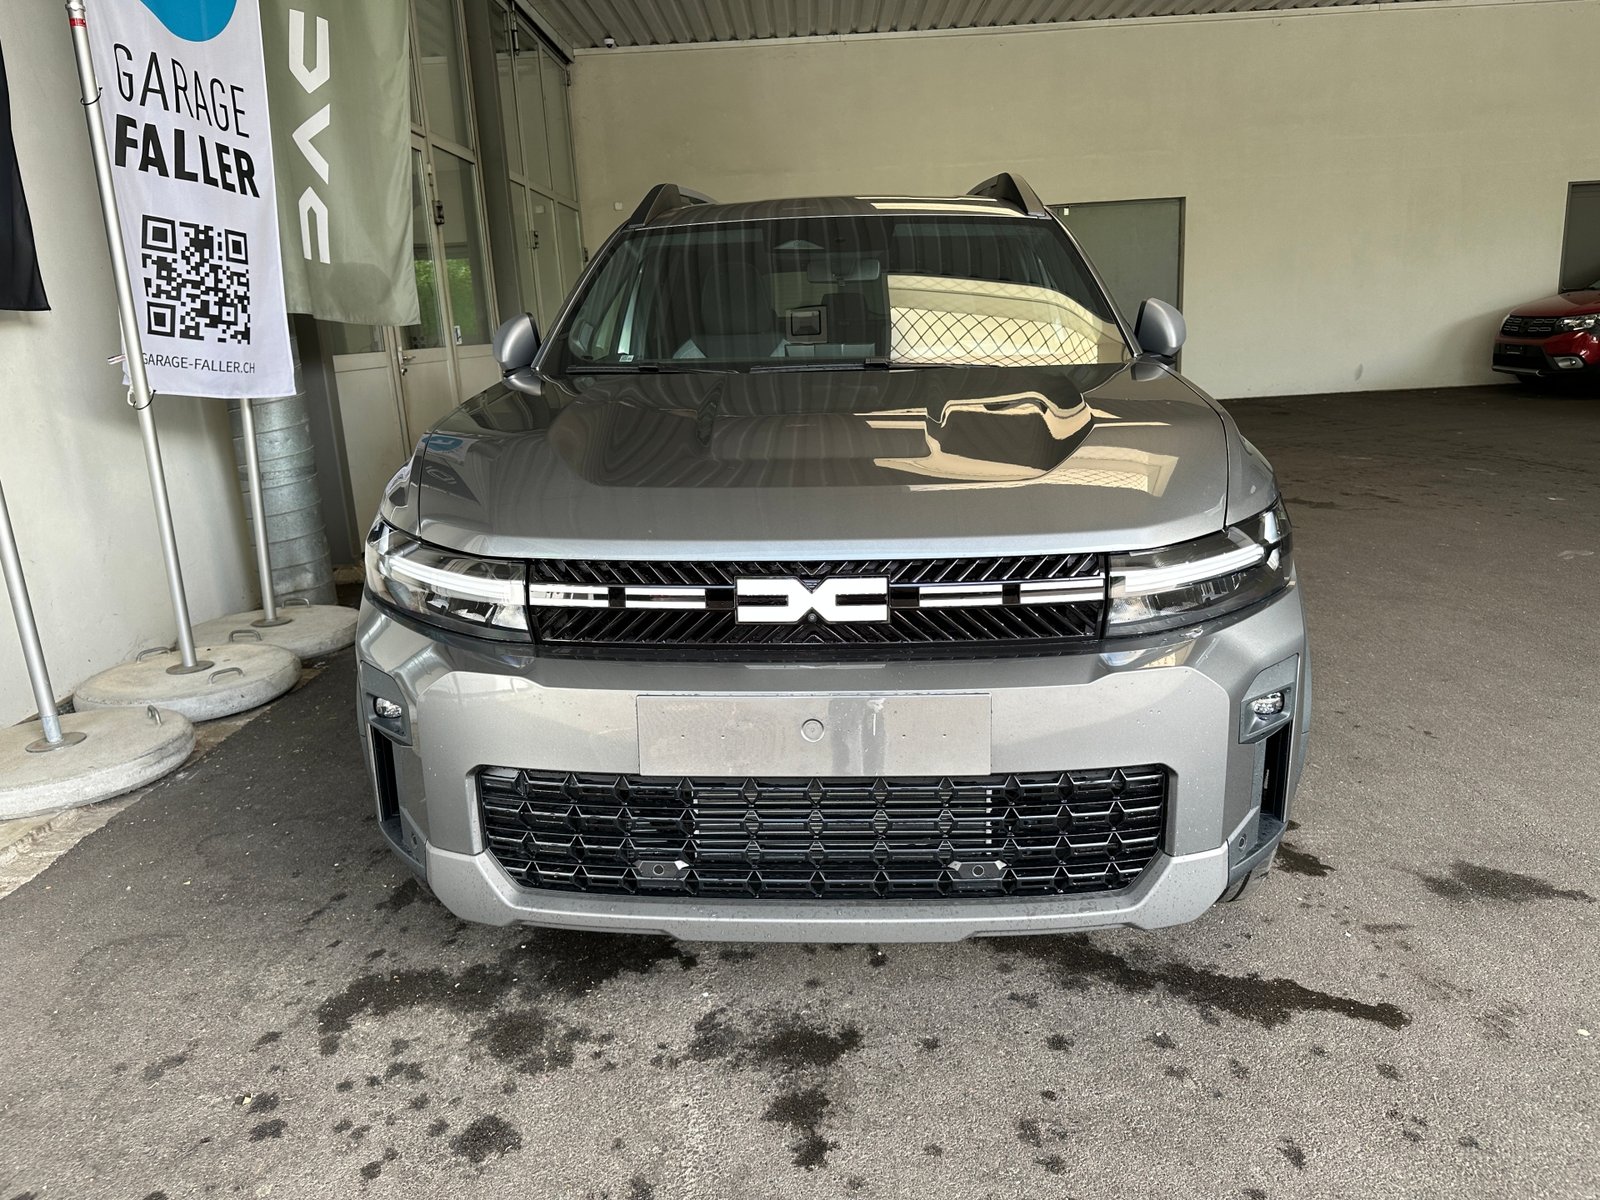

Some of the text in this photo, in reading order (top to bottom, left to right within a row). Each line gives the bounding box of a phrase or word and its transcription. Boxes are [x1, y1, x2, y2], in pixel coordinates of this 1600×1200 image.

[114, 43, 249, 138] GARAGE
[115, 114, 260, 198] FALLER
[142, 353, 255, 374] GARAGE-FALLER.CH
